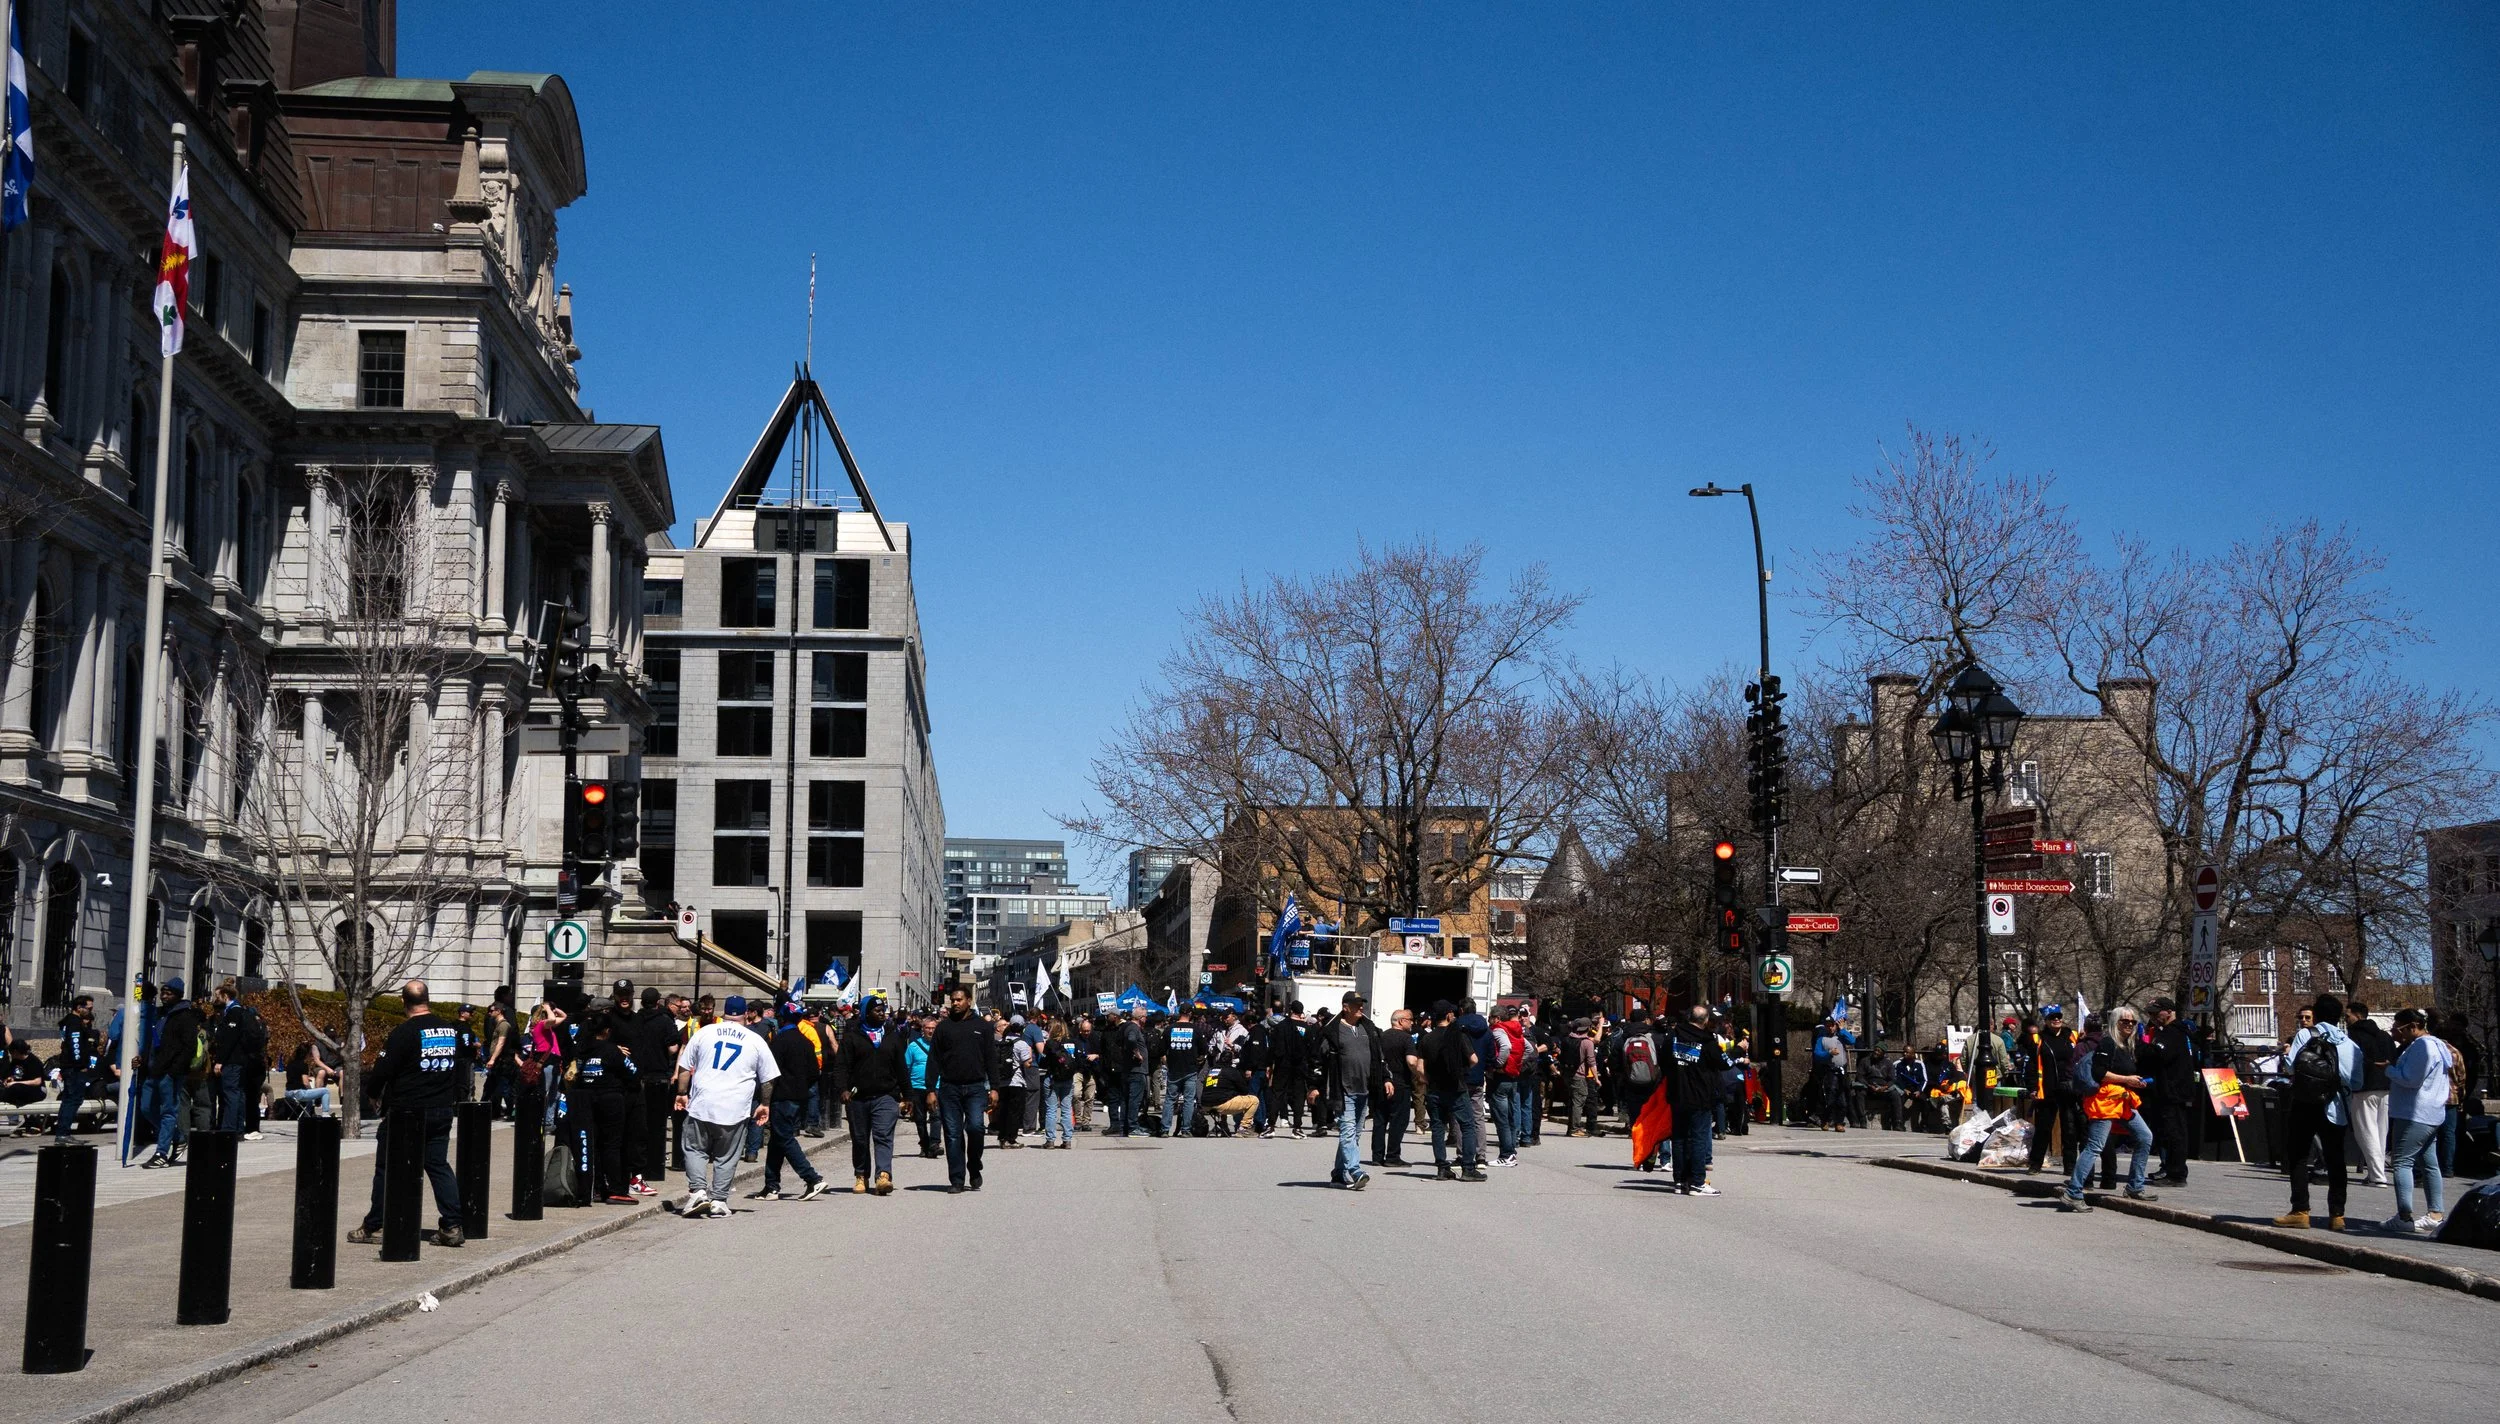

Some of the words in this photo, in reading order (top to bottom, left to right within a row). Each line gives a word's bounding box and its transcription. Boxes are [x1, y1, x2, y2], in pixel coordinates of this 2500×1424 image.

[1998, 881, 2024, 891] Marché
[2025, 882, 2069, 892] Bonsecours
[1785, 922, 1836, 931] acques-Cartier
[423, 1028, 456, 1038] BLEUS
[717, 1028, 746, 1041] OHTANI
[712, 1040, 743, 1071] 17
